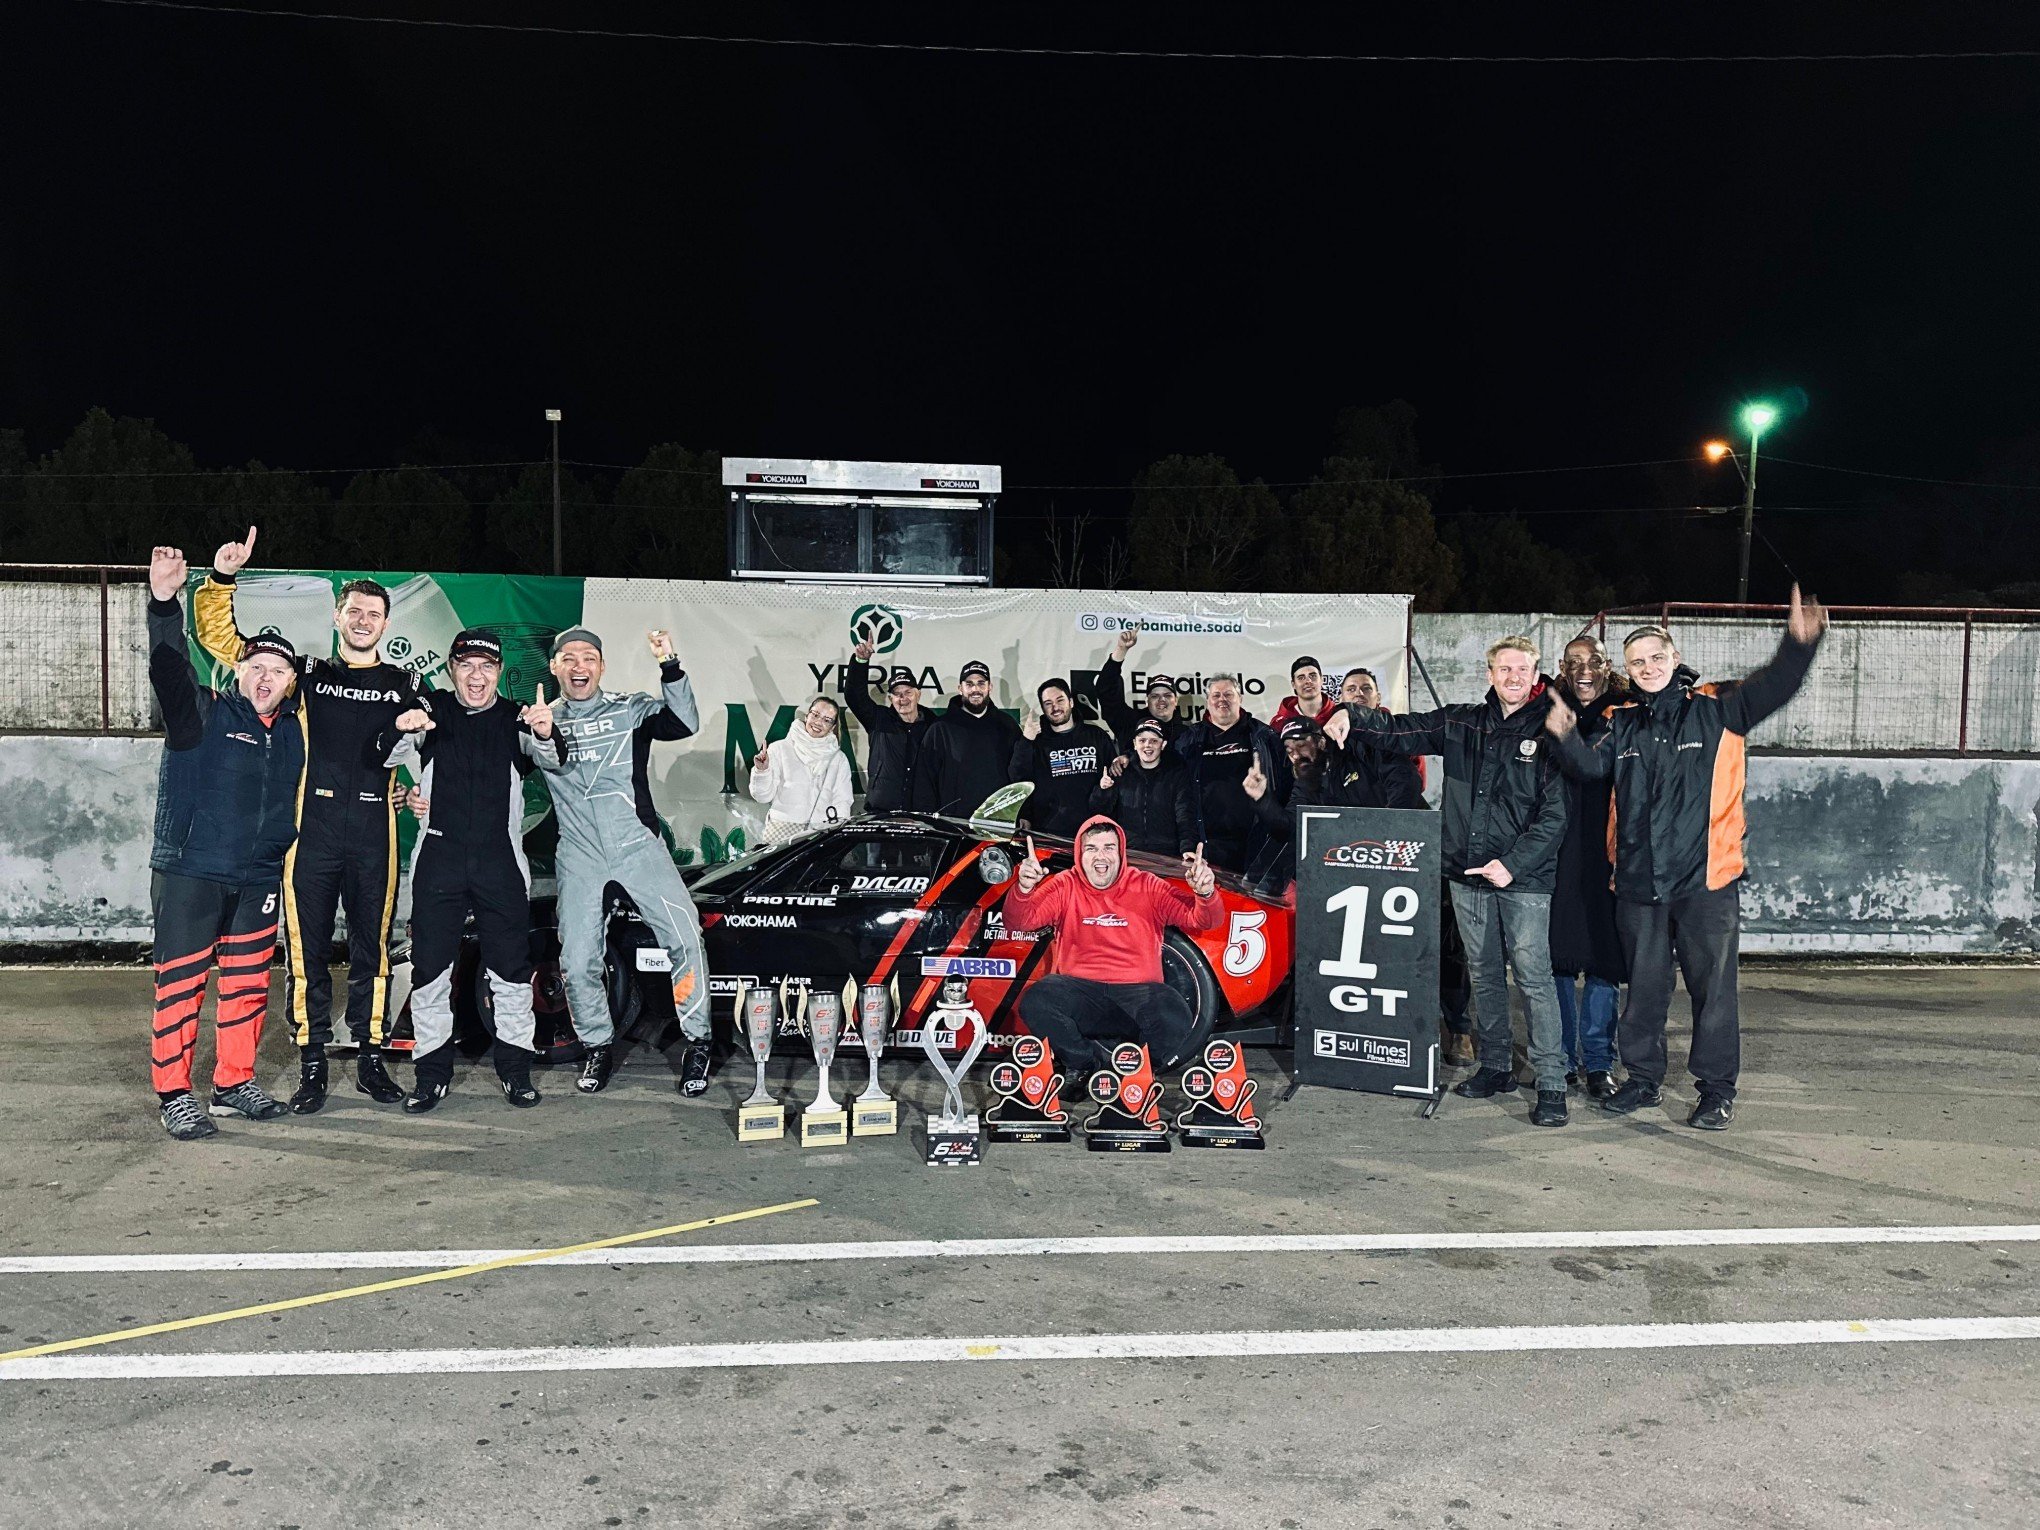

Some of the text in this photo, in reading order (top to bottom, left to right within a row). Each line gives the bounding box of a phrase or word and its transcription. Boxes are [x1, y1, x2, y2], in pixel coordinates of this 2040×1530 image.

[762, 475, 805, 485] YOKOHAMA
[936, 480, 978, 489] YOKOHAMA
[257, 641, 294, 657] YOKOHAMA
[466, 640, 500, 653] YOKOHAMA
[315, 682, 381, 701] UNICRED
[1049, 746, 1097, 762] sparco
[1336, 845, 1399, 866] CGST
[851, 876, 930, 890] DACAR
[261, 892, 276, 914] 5
[743, 896, 837, 906] PRO TUNE
[724, 914, 797, 928] YOKOHAMA
[984, 929, 1009, 940] DETAIL
[1223, 910, 1267, 977] 5
[770, 976, 812, 985] JL ASER
[1329, 984, 1408, 1017] GT
[911, 1031, 954, 1044] DVE
[1338, 1038, 1359, 1052] sul
[1363, 1040, 1407, 1057] filmes
[1366, 1053, 1407, 1065] Filmes Stretch
[934, 1142, 953, 1156] 6
